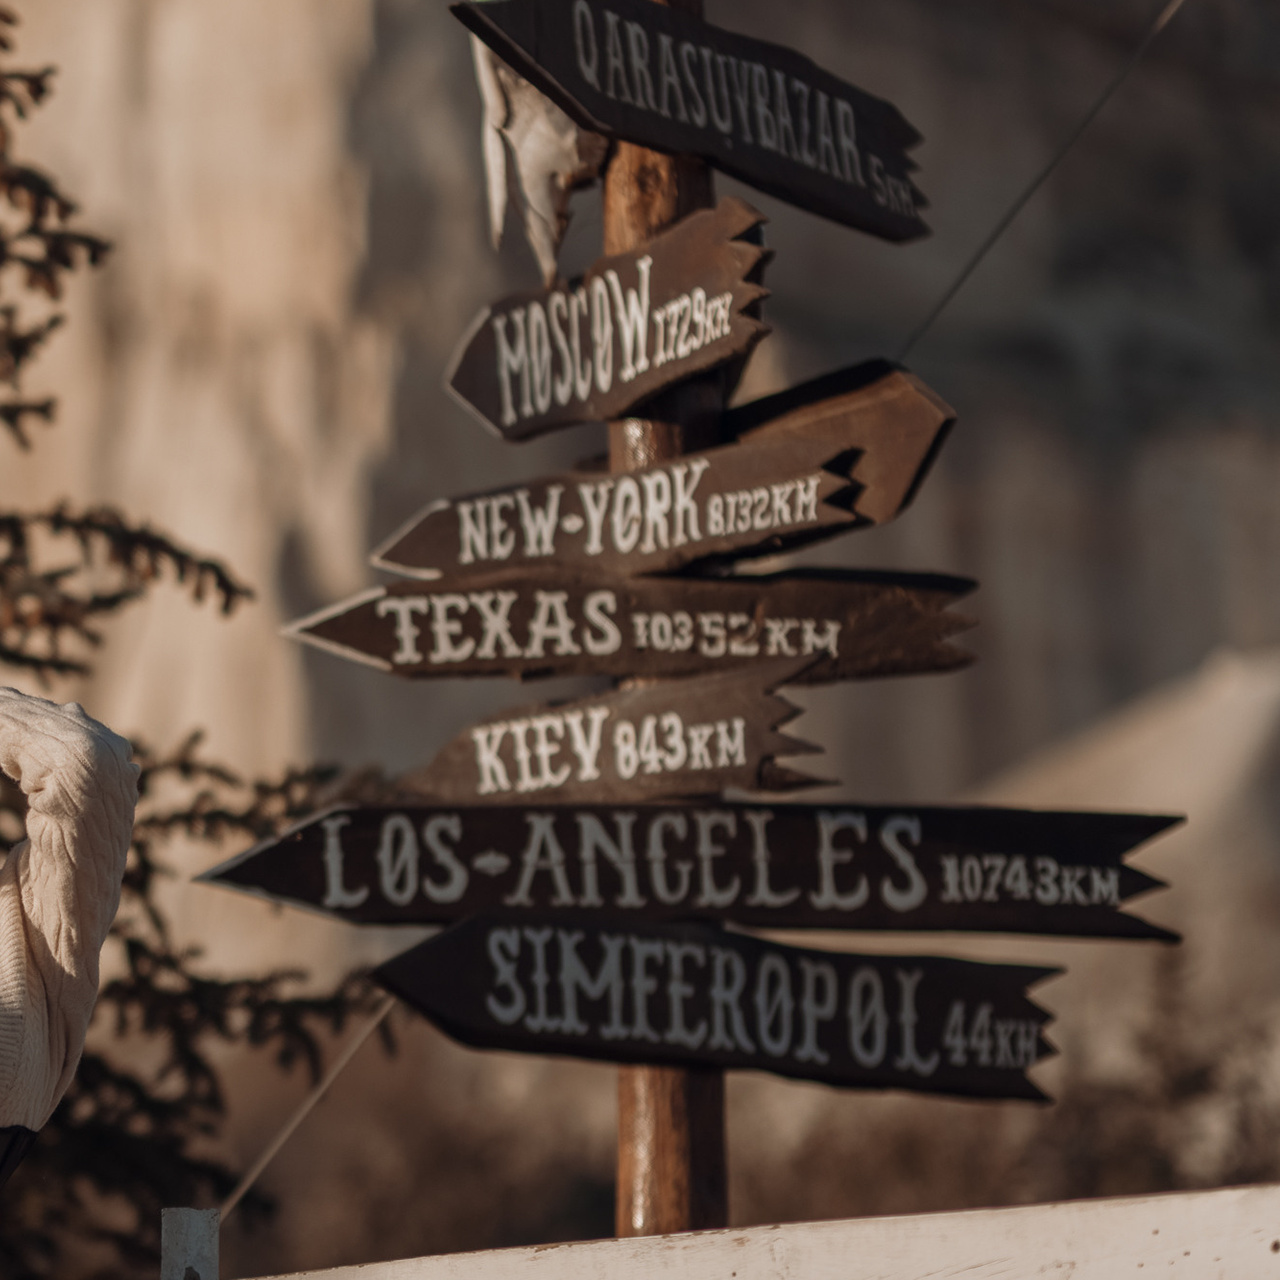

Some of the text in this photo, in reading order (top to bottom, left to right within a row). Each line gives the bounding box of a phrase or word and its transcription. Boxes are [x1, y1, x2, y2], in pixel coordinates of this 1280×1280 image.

[494, 256, 653, 425] MOSCOW
[458, 458, 709, 563] NEW-YORK
[378, 590, 622, 663] TEXAS
[939, 854, 1120, 906] 10743KM
